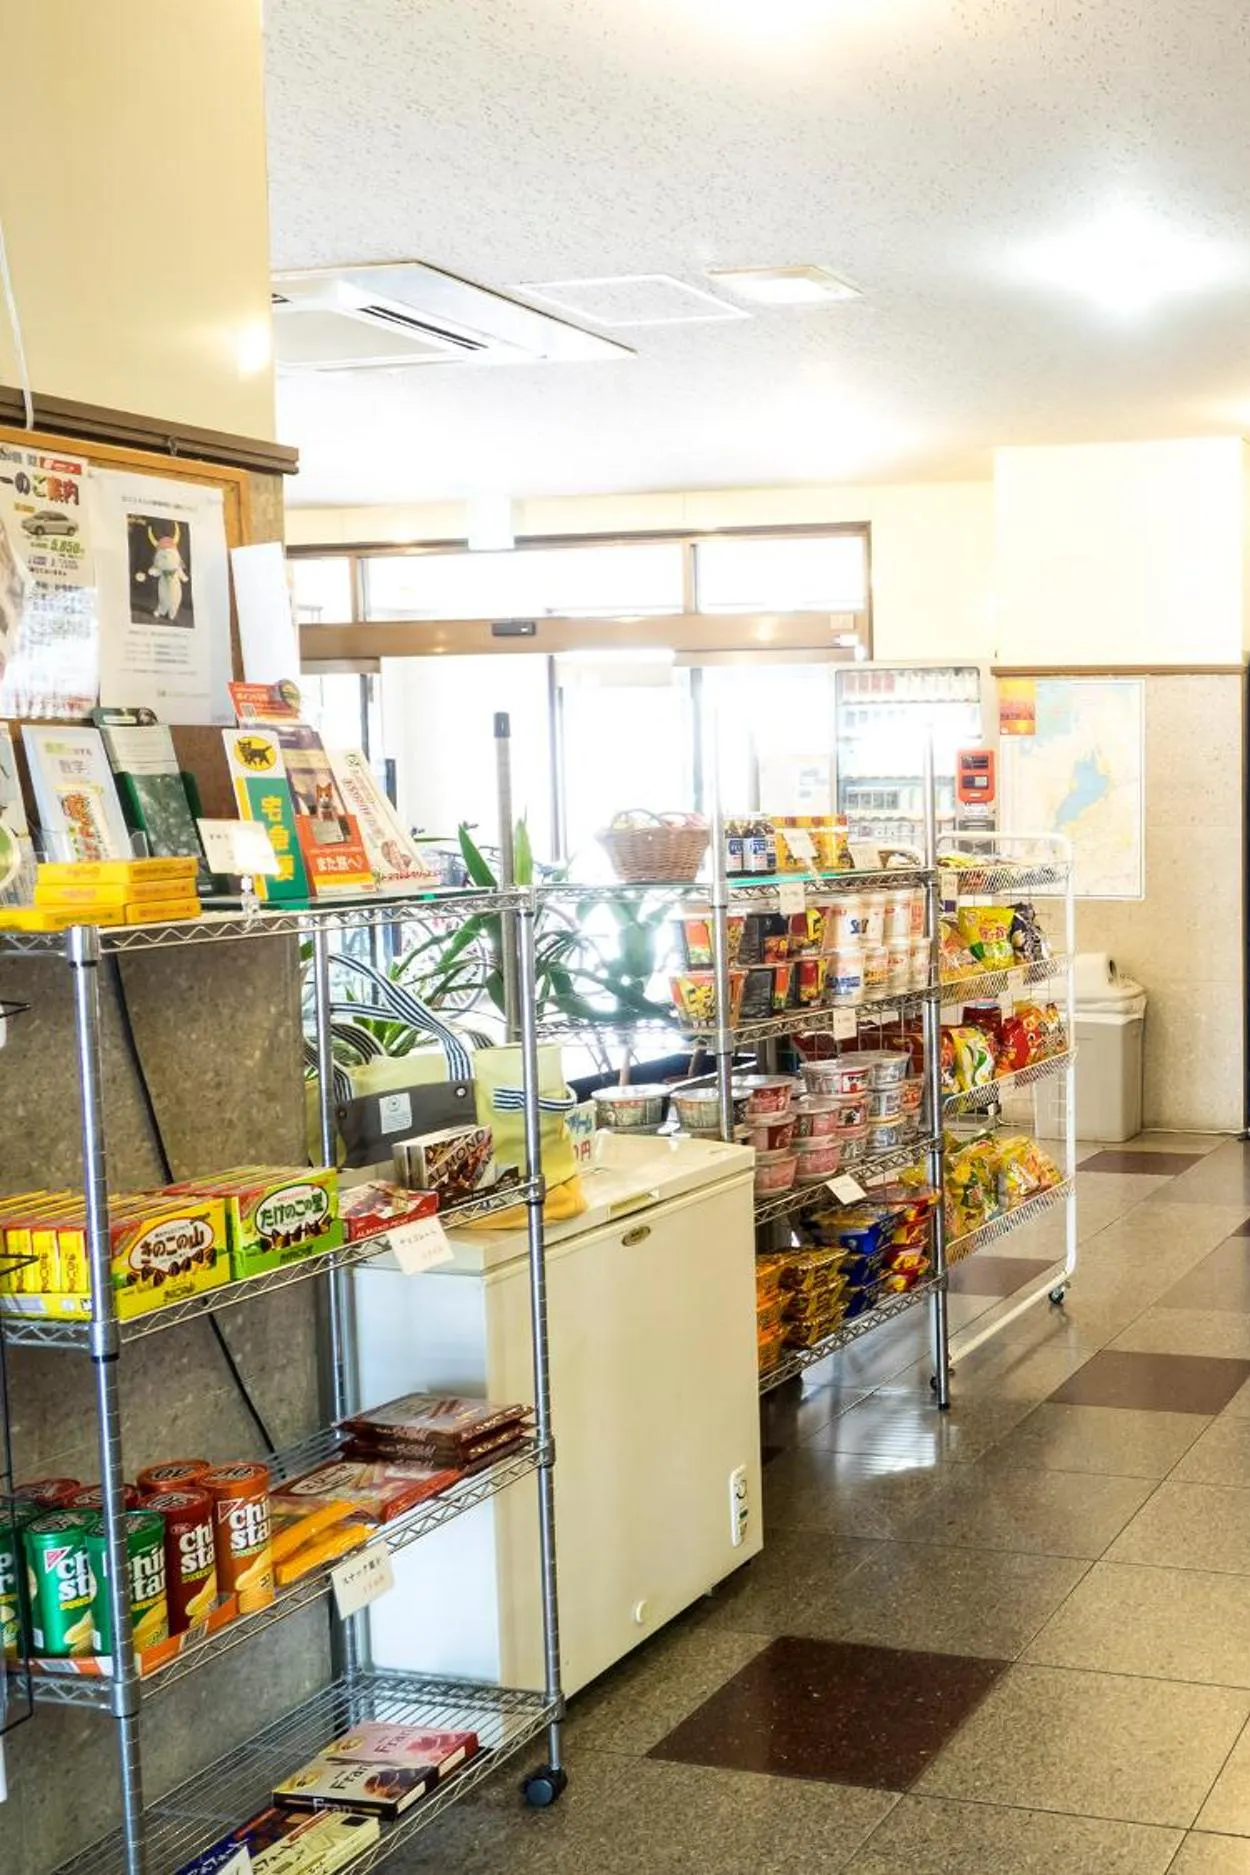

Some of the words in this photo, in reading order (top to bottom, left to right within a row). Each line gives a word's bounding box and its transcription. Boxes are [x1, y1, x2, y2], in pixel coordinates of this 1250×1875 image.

[427, 1129, 486, 1186] ALMOND
[259, 1191, 324, 1231] たけのこの里
[139, 1225, 205, 1266] きのこの山
[229, 1497, 269, 1529] chi
[230, 1521, 269, 1551] sta
[180, 1544, 215, 1575] sta
[328, 1763, 374, 1789] Fran
